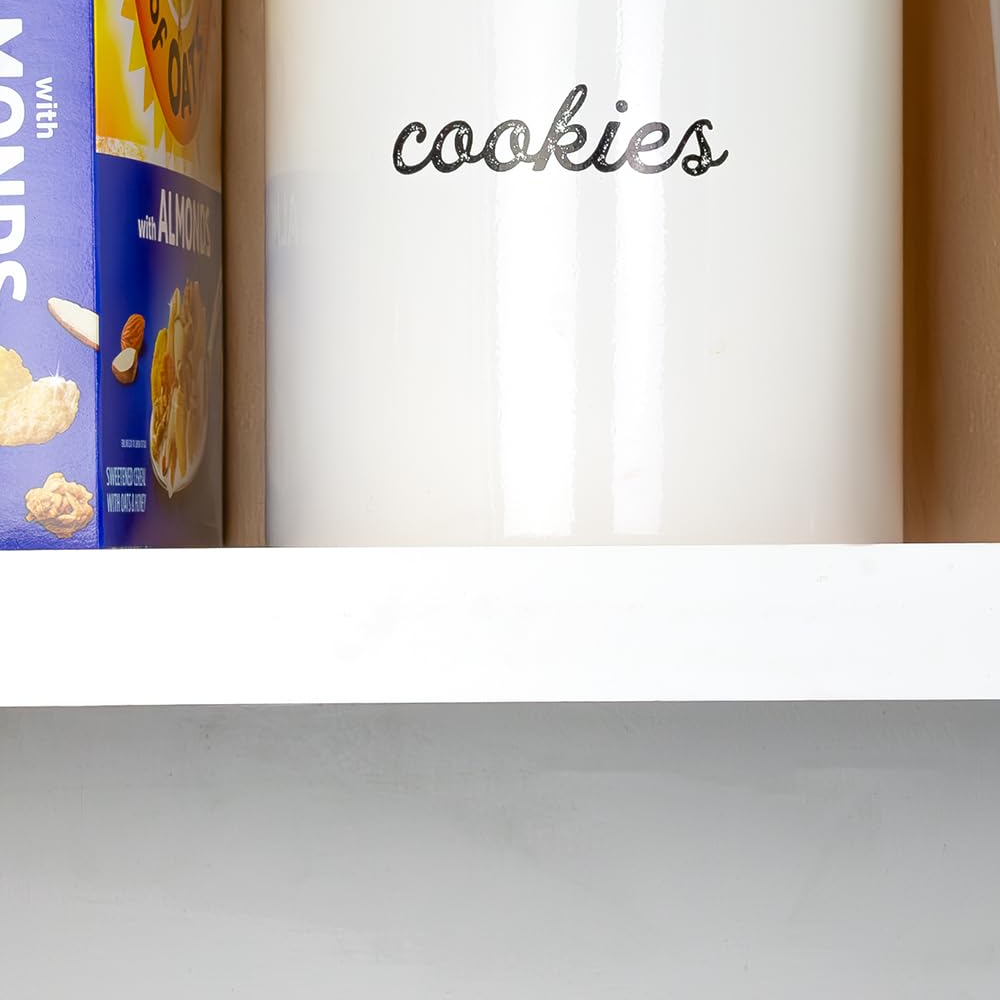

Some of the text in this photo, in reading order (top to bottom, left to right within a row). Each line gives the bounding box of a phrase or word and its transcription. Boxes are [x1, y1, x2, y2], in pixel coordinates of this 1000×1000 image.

[36, 77, 58, 138] with
[393, 85, 728, 176] cookies
[138, 189, 211, 257] with ALMONDS
